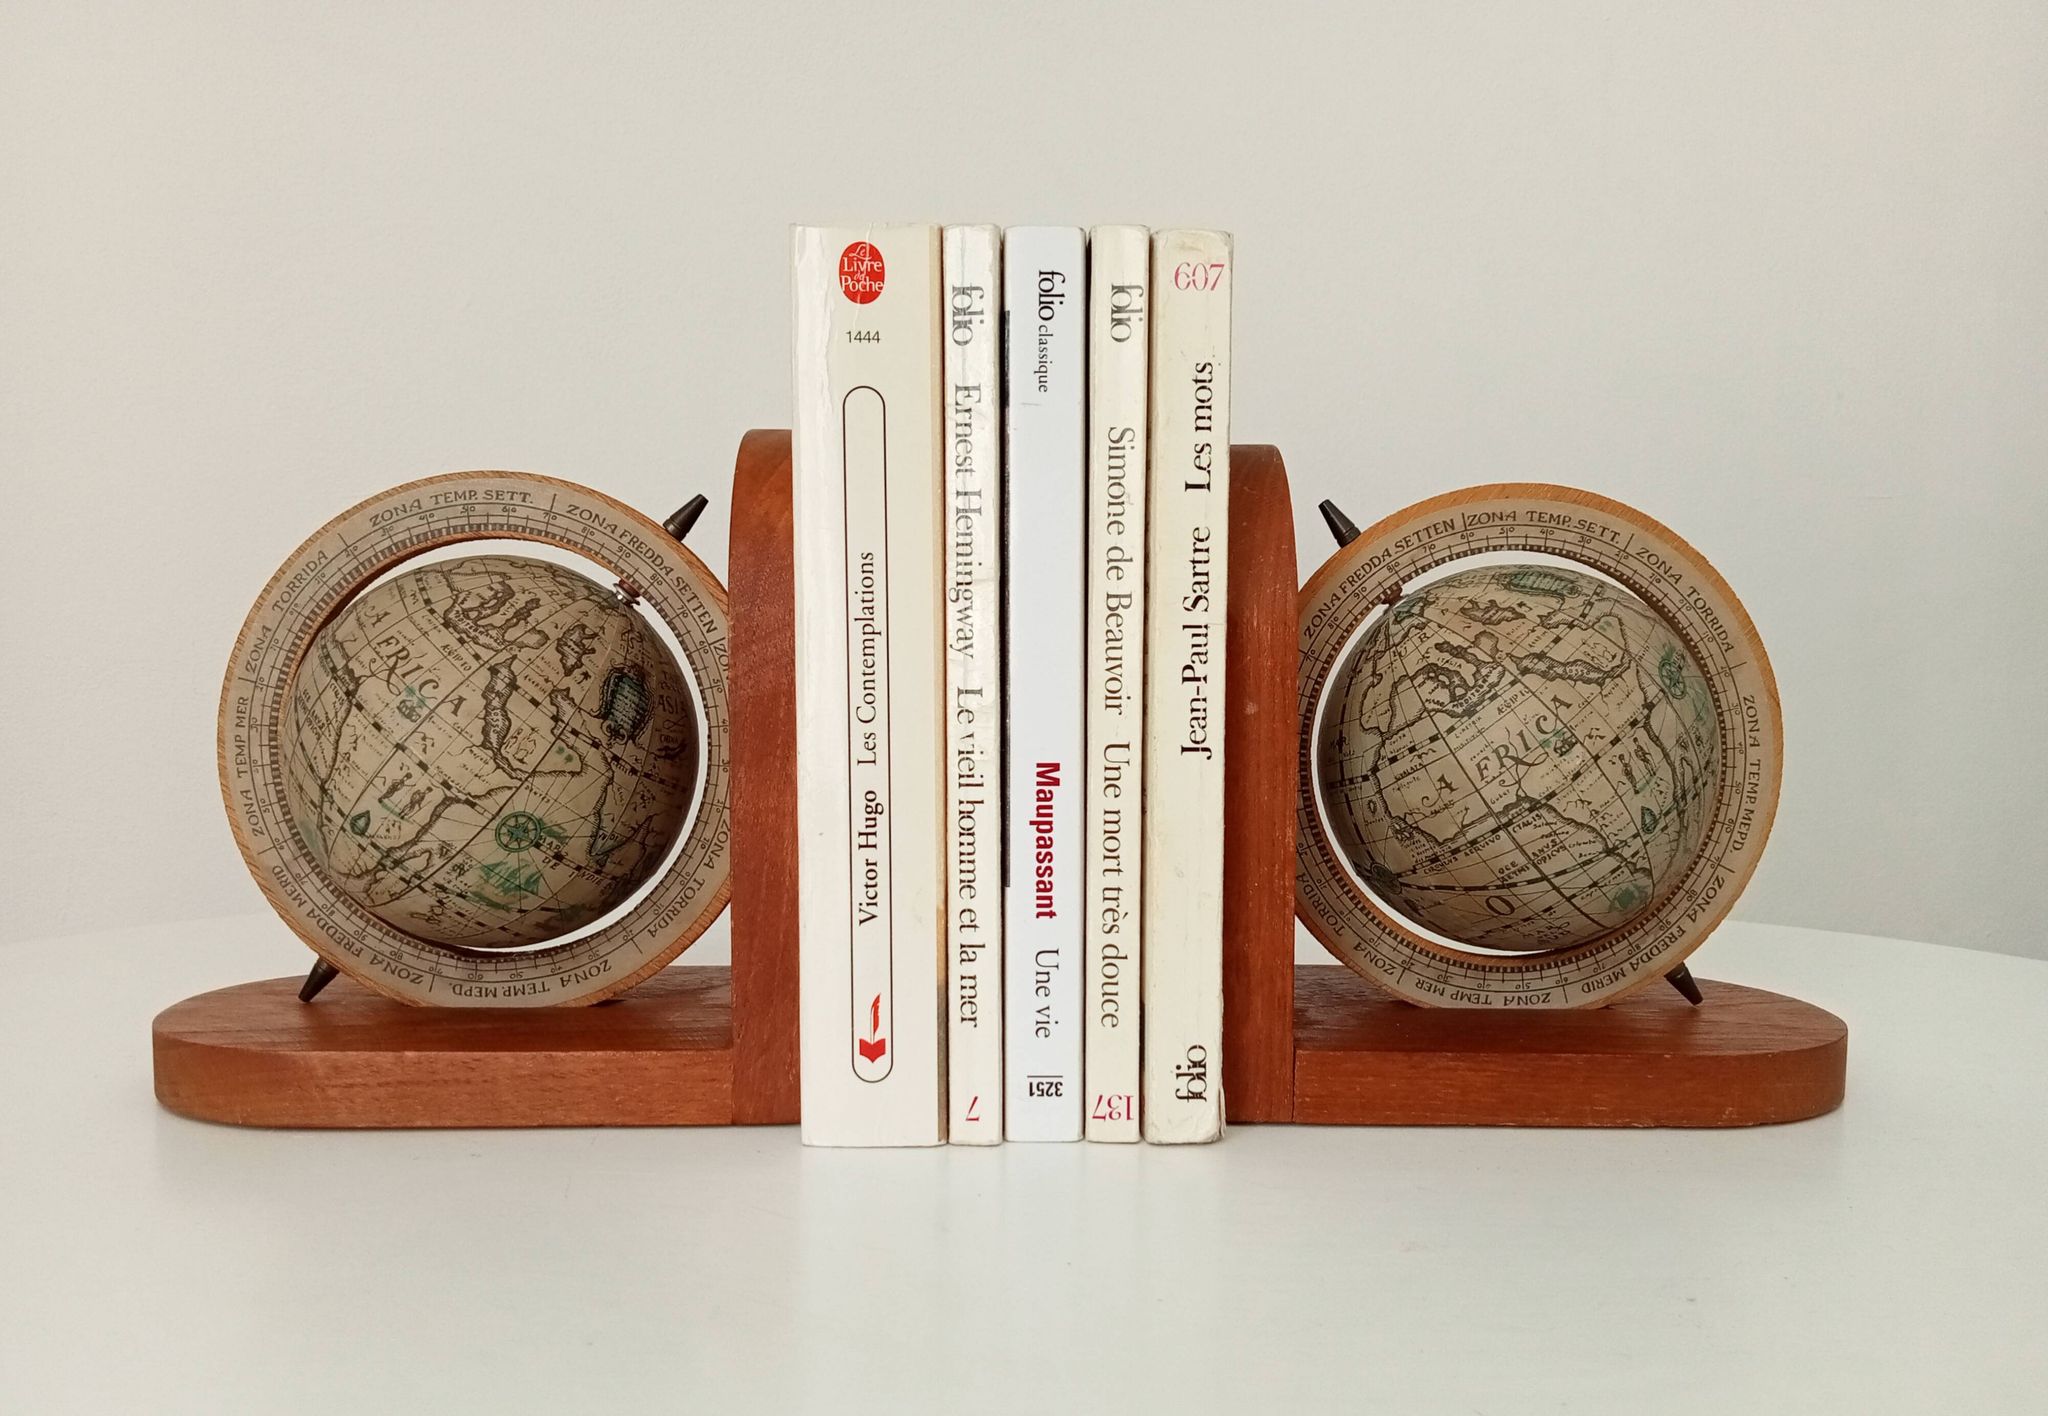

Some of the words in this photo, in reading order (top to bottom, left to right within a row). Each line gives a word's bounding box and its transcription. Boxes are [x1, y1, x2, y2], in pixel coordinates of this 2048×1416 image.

[841, 276, 885, 293] Poche
[843, 257, 883, 273] Livre
[1174, 262, 1225, 292] 607
[952, 284, 985, 347] folio
[1038, 269, 1066, 321] folio
[1110, 284, 1144, 343] folio
[846, 331, 881, 344] 1444
[1033, 324, 1054, 393] classique
[1191, 361, 1214, 433] mots
[955, 383, 982, 478] Ernest
[1106, 427, 1136, 536] Simone
[1184, 442, 1212, 493] Les
[369, 498, 422, 528] ZONA
[481, 489, 534, 504] SETT.
[1467, 510, 1517, 527] ZONA
[566, 503, 617, 535] ZONA
[619, 529, 674, 577] FREDDA
[671, 575, 718, 634] SETTEN
[949, 488, 983, 660] Hemingway
[1106, 546, 1134, 581] de
[1182, 526, 1211, 613] Sartre
[1304, 597, 1341, 639] ZONA
[1339, 548, 1393, 594] FREDDA
[1395, 518, 1456, 554] SETTEN
[245, 625, 272, 674] ZONA
[272, 550, 329, 613] TORRIDA
[1636, 547, 1683, 585] ZONA
[1686, 586, 1735, 653] TORRIDA
[854, 552, 882, 724] Contemplations
[1104, 591, 1133, 716] Beauvoir
[235, 696, 250, 729] MER
[957, 686, 985, 724] Le
[1180, 623, 1213, 761] Jean-Paul
[1743, 695, 1761, 748] ZONA
[234, 734, 247, 779] TEMP
[856, 732, 877, 766] Les
[957, 731, 985, 790] vieil
[1103, 741, 1131, 798] Une
[239, 789, 266, 837] ZONA
[857, 790, 884, 850] Hugo
[704, 819, 730, 870] ZONA
[958, 799, 985, 900] homme
[1029, 762, 1061, 919] Maupassant
[1102, 808, 1124, 877] mort
[272, 864, 307, 909] MERID
[647, 878, 705, 938] TORRIDA
[859, 858, 879, 926] Victor
[1101, 886, 1129, 934] très
[1297, 872, 1346, 937] TORRIDA
[1686, 874, 1725, 923] ZONA
[306, 908, 363, 958] FREDDA
[959, 908, 980, 934] et
[370, 957, 425, 985] ZONA
[560, 958, 613, 988] ZONA
[959, 943, 986, 966] la
[1035, 948, 1060, 998] Une
[1353, 942, 1397, 976] ZONA
[1629, 926, 1686, 972] FREDDA
[960, 974, 978, 1029] mer
[1101, 943, 1128, 1028] douce
[1415, 977, 1446, 997] MER
[1450, 989, 1492, 1006] TEMP
[1504, 991, 1552, 1006] ZONA
[1582, 967, 1626, 994] MERID
[1035, 1005, 1059, 1038] vie
[1028, 1081, 1064, 1097] 3251
[1175, 1044, 1207, 1103] folio
[965, 1096, 980, 1122] 7
[1092, 1094, 1135, 1122] 137
